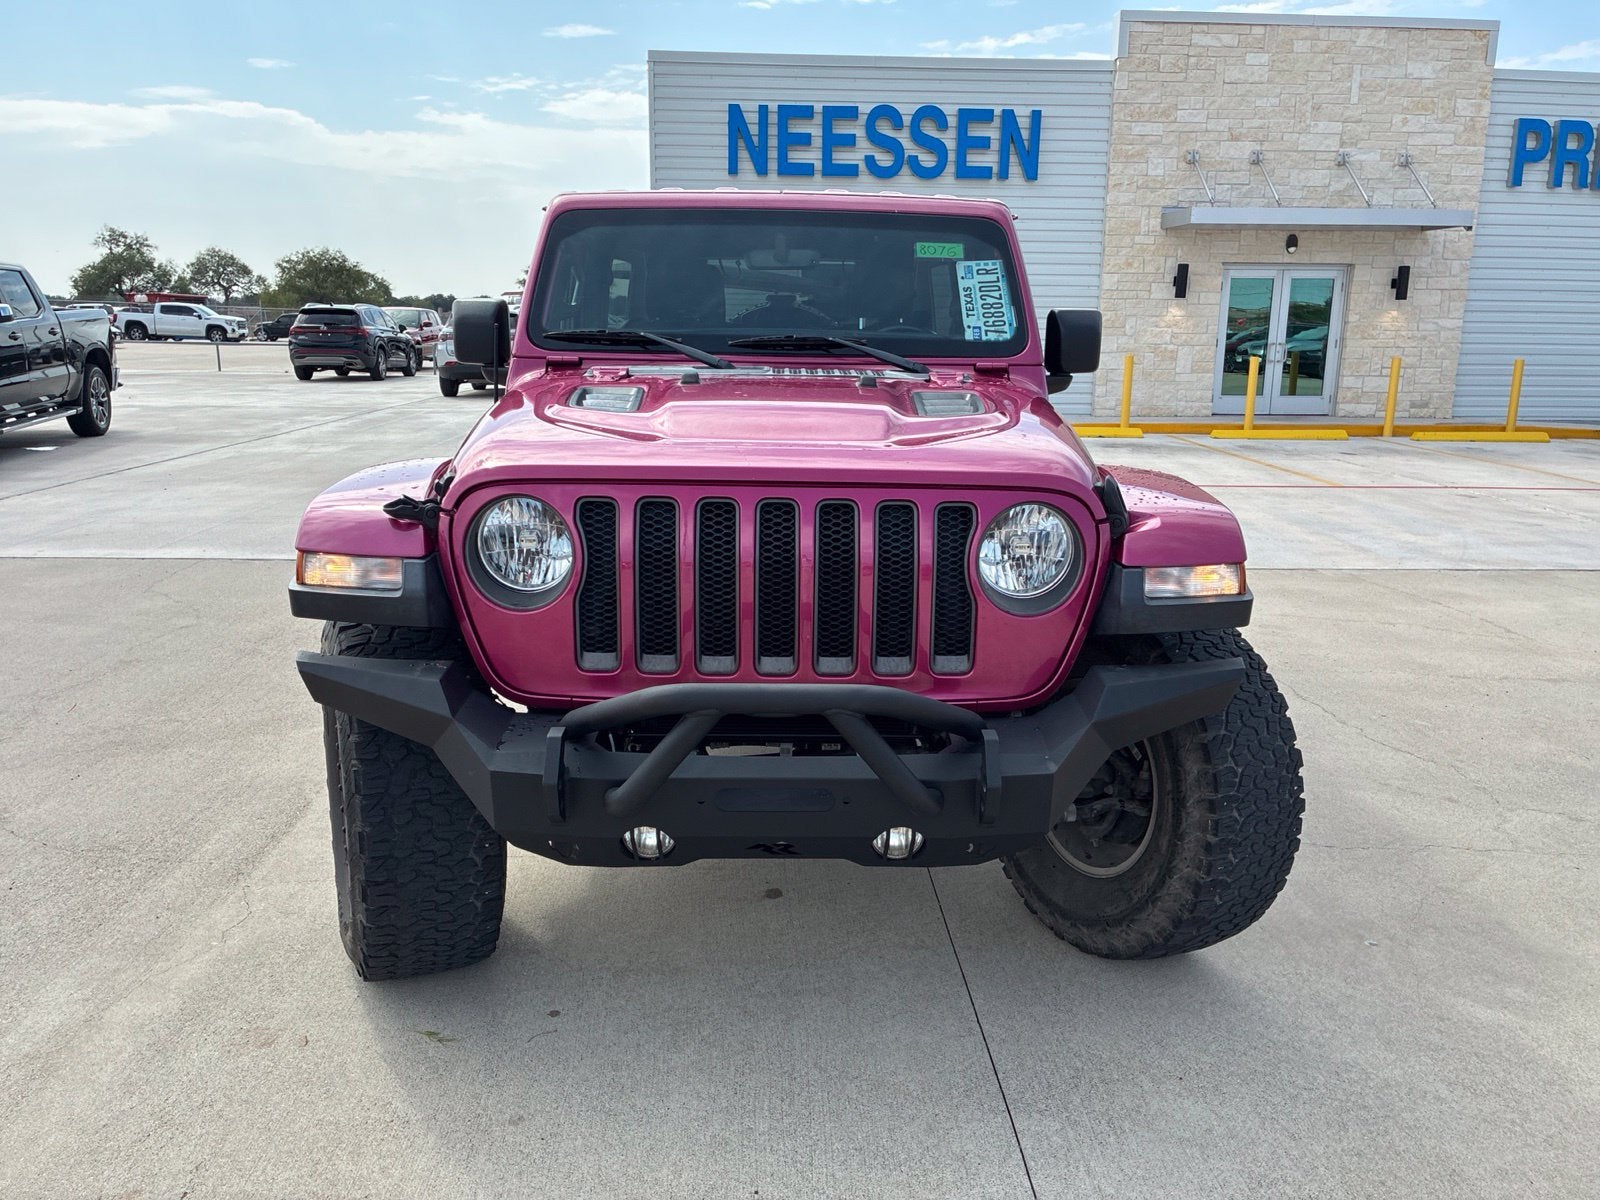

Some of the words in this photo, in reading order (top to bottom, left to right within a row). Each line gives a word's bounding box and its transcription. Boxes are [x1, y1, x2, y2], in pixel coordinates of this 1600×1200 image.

[728, 103, 1042, 181] NEESSEN
[1508, 117, 1600, 189] PR
[919, 244, 957, 257] 8076
[963, 286, 975, 318] TEXAS
[976, 267, 1008, 337] 76882DLR
[973, 327, 981, 339] FEB
